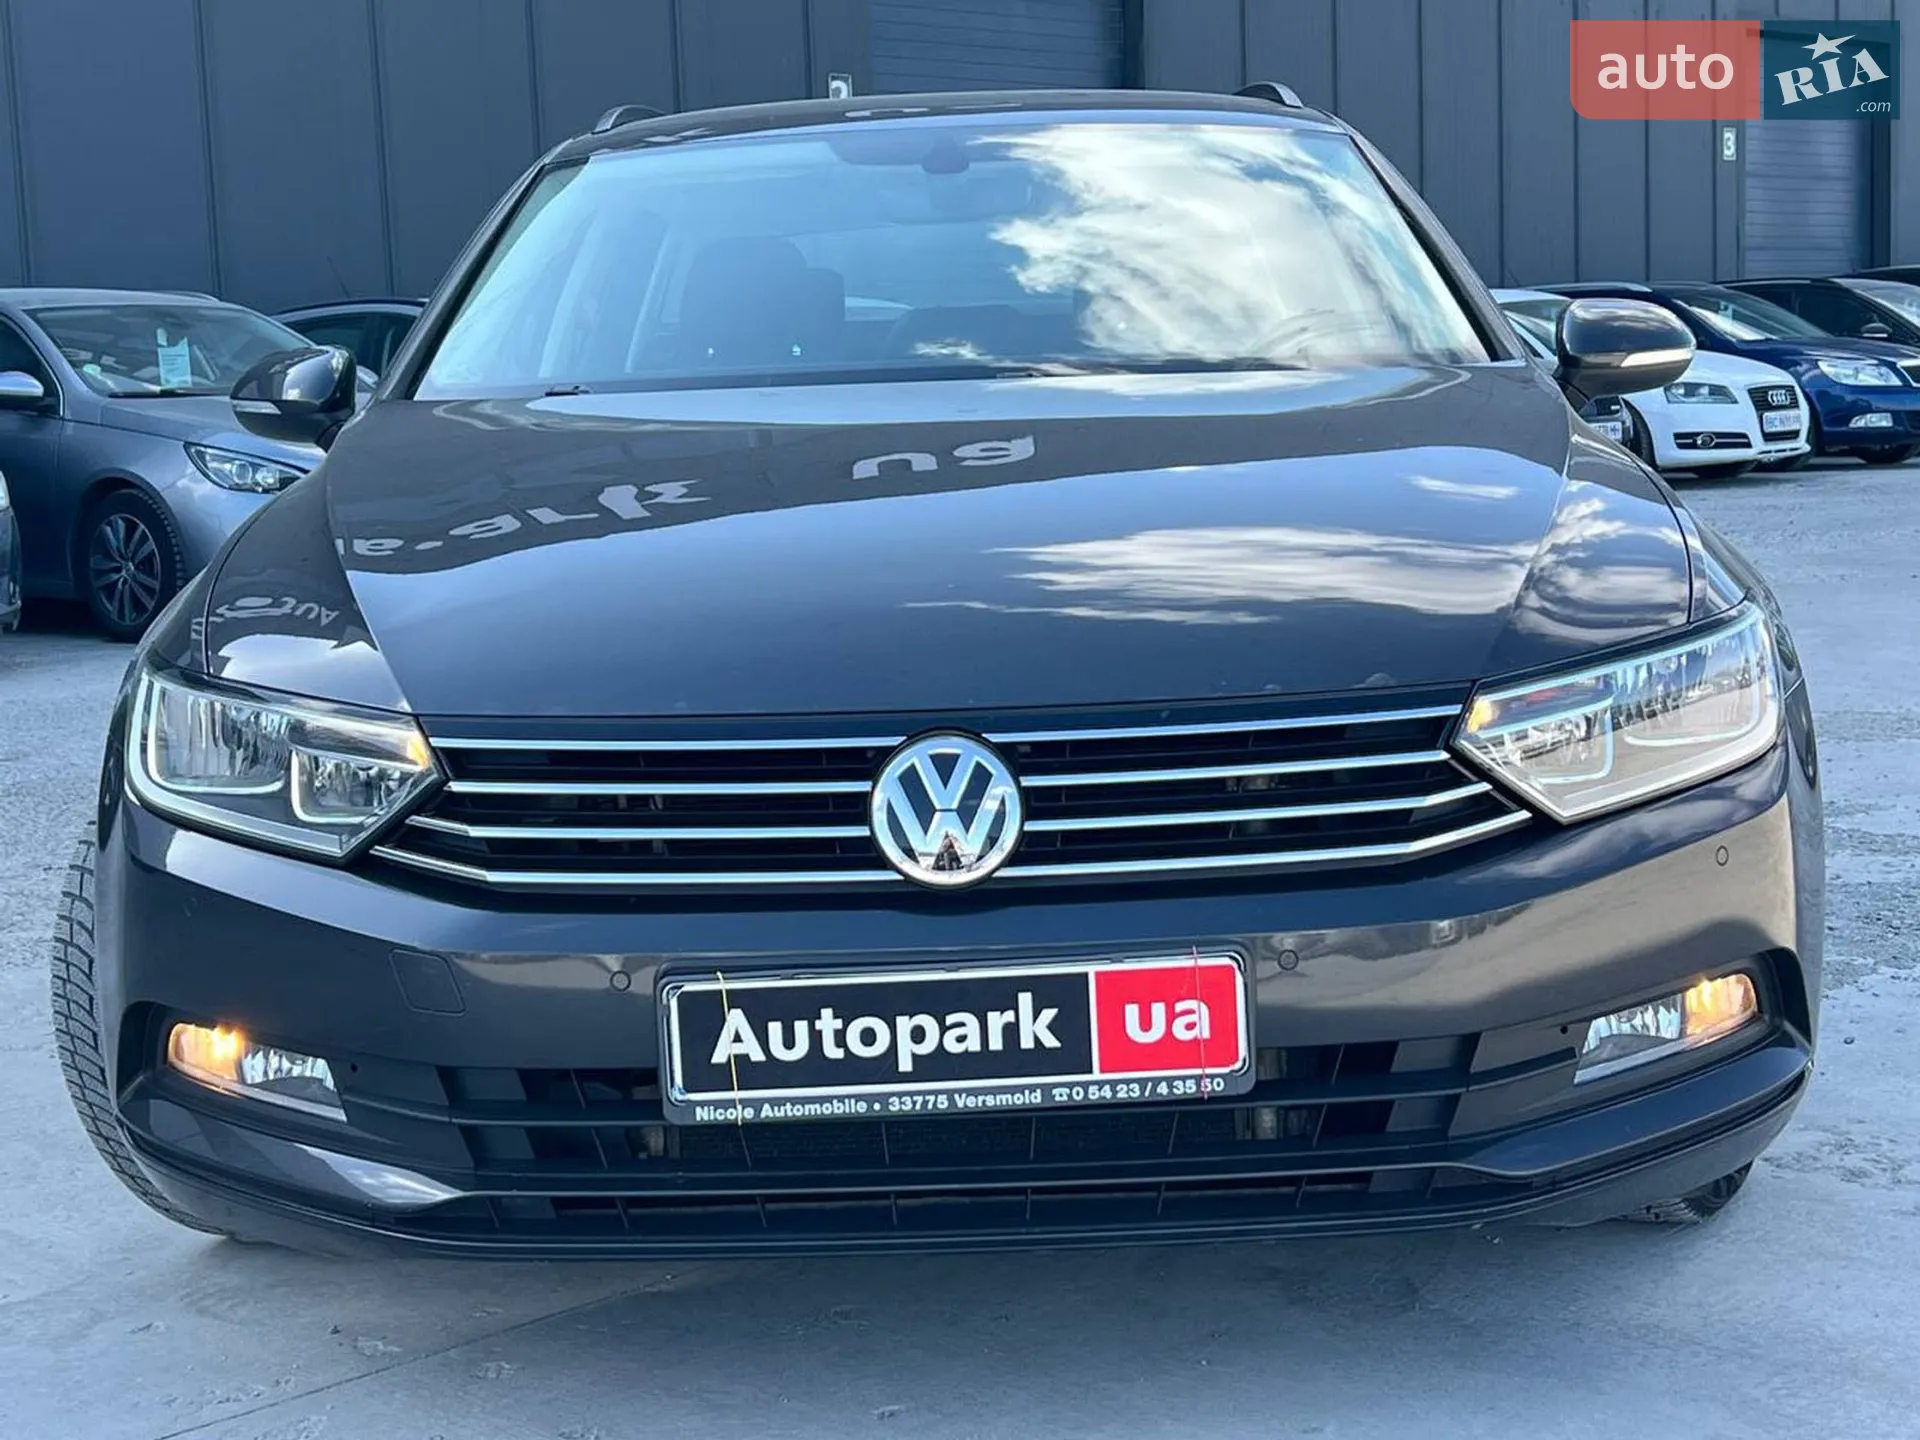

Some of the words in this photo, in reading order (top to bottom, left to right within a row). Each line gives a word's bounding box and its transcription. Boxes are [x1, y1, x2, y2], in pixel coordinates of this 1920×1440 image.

[1723, 131, 1735, 156] 3
[710, 991, 1062, 1072] Autopark
[1124, 997, 1211, 1045] ua
[695, 1105, 755, 1122] Nicole
[760, 1098, 868, 1119] Automobile
[887, 1092, 949, 1112] 33775
[953, 1087, 1042, 1109] Versmold
